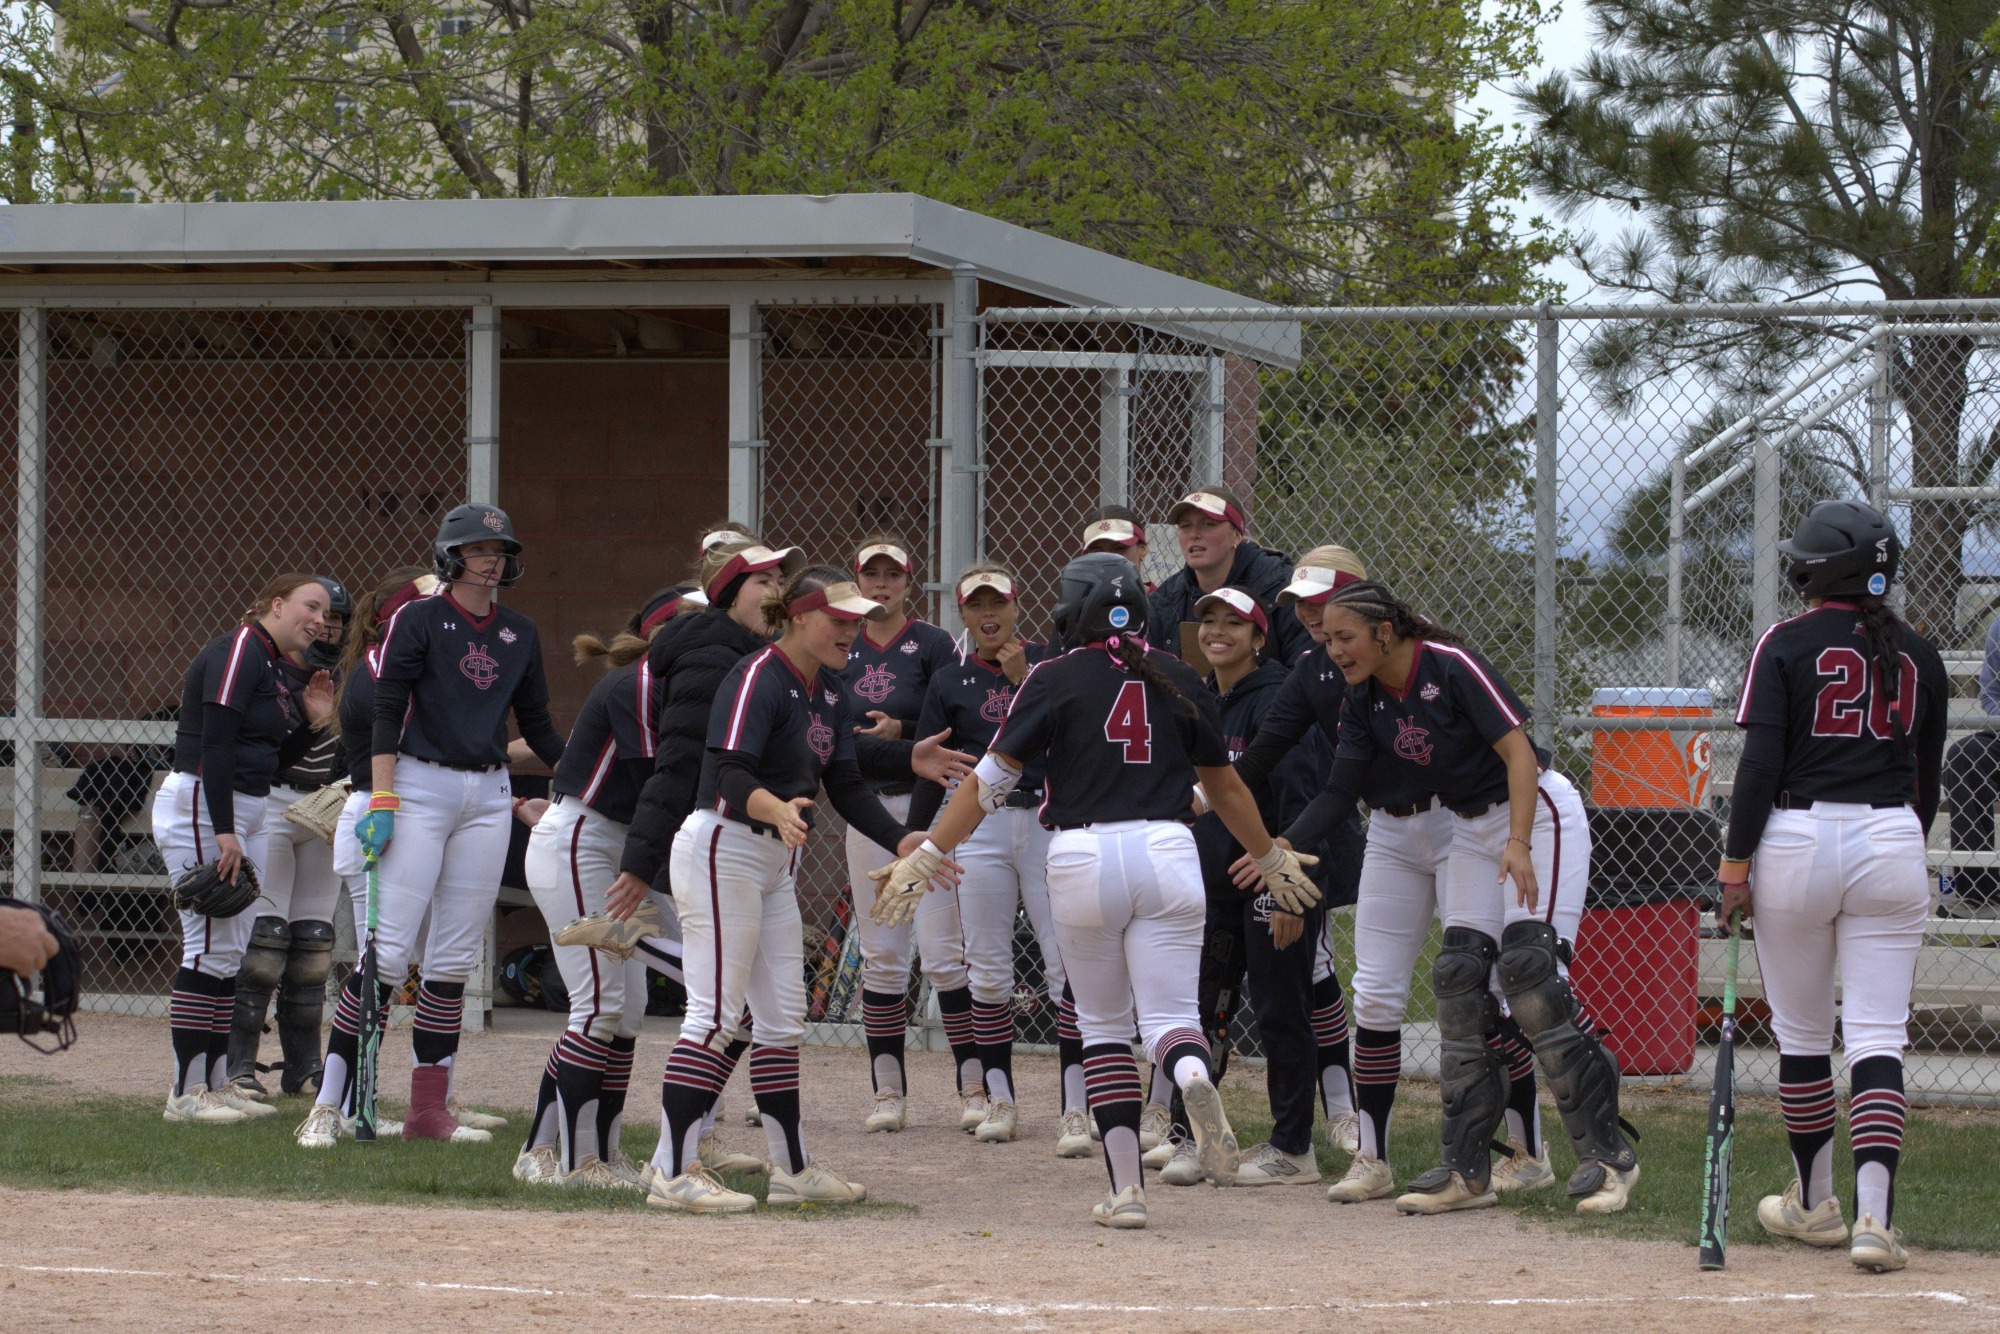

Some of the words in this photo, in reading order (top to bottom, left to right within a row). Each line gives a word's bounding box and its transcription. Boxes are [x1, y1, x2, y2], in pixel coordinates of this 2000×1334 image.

[1876, 552, 1888, 562] 20
[1115, 588, 1121, 598] 4
[499, 631, 517, 641] RMAC
[900, 643, 919, 653] RMAC
[1420, 686, 1440, 698] RMAC
[1811, 647, 1918, 740] 20
[1104, 680, 1151, 763] 4
[1693, 732, 1711, 772] G
